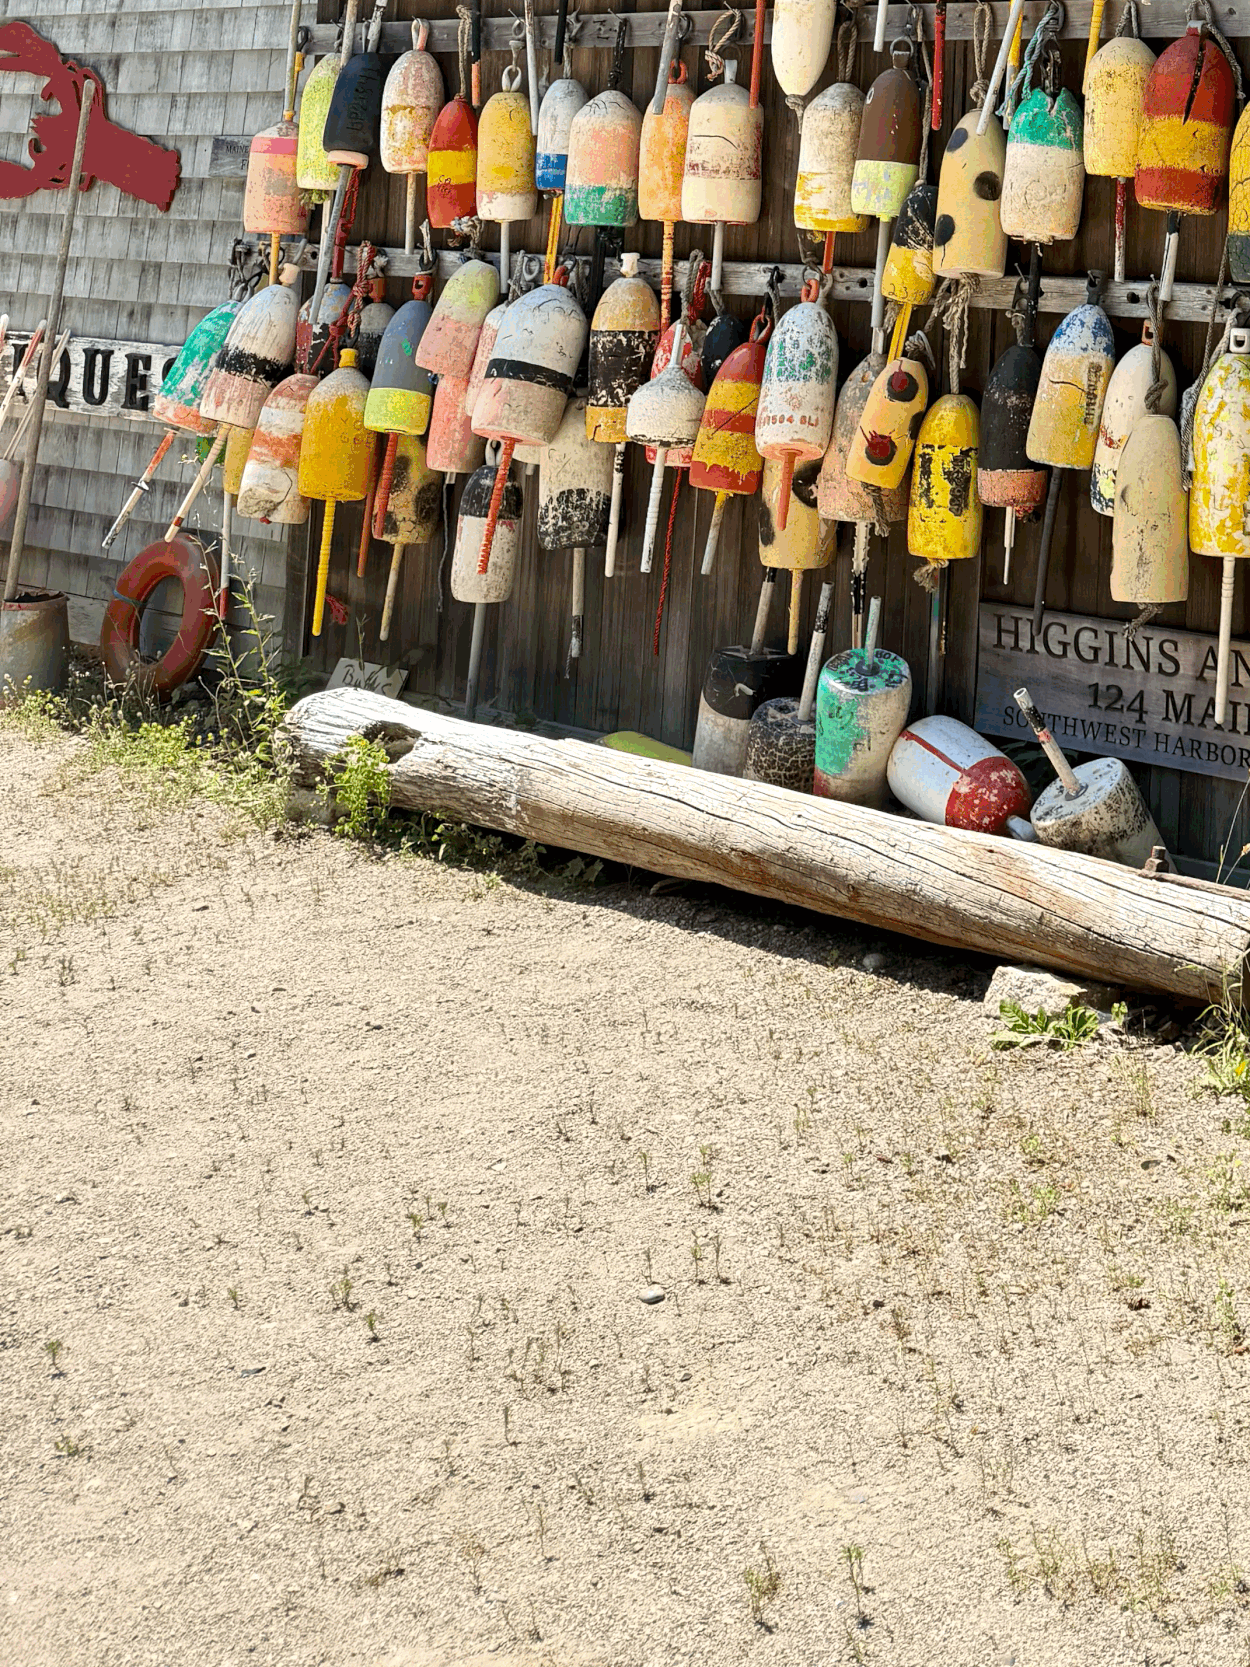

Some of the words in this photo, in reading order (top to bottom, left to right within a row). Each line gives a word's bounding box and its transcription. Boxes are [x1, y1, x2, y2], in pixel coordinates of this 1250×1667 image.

[993, 613, 1181, 677] HIGGINS
[1088, 682, 1148, 725] 124
[1003, 705, 1147, 751] SOTHWEST
